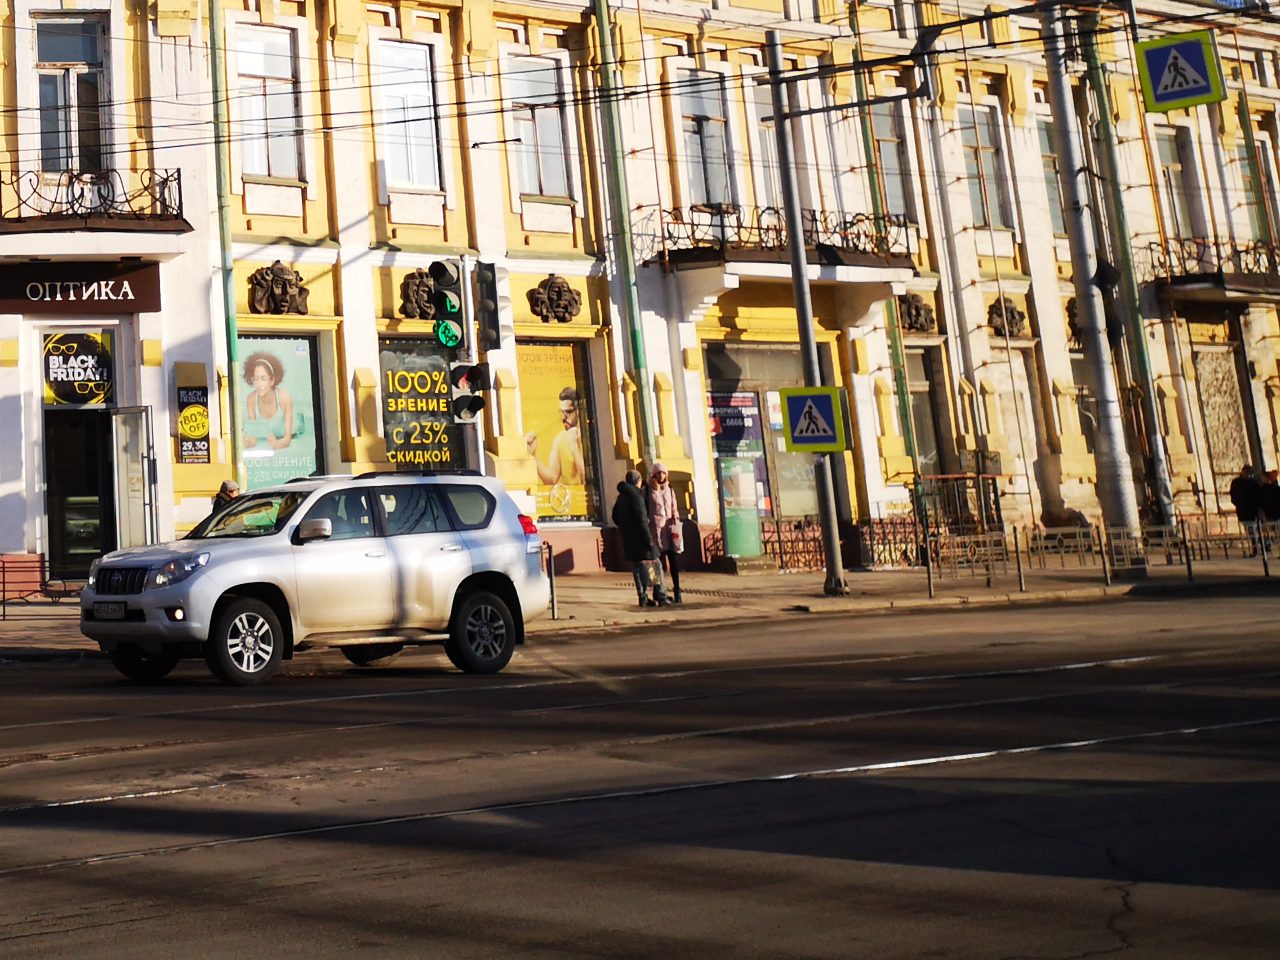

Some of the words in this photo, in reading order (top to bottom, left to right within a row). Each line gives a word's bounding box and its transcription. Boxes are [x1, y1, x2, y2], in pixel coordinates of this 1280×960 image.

[26, 280, 136, 301] ОПТИКА
[49, 355, 98, 369] BLACK
[49, 367, 108, 382] FRIDAY!
[386, 370, 448, 394] 100%
[387, 398, 448, 412] ЗРЕНИЕ
[188, 422, 207, 433] OFF
[409, 421, 449, 444] 23%
[387, 446, 451, 464] СКИДКОЙ
